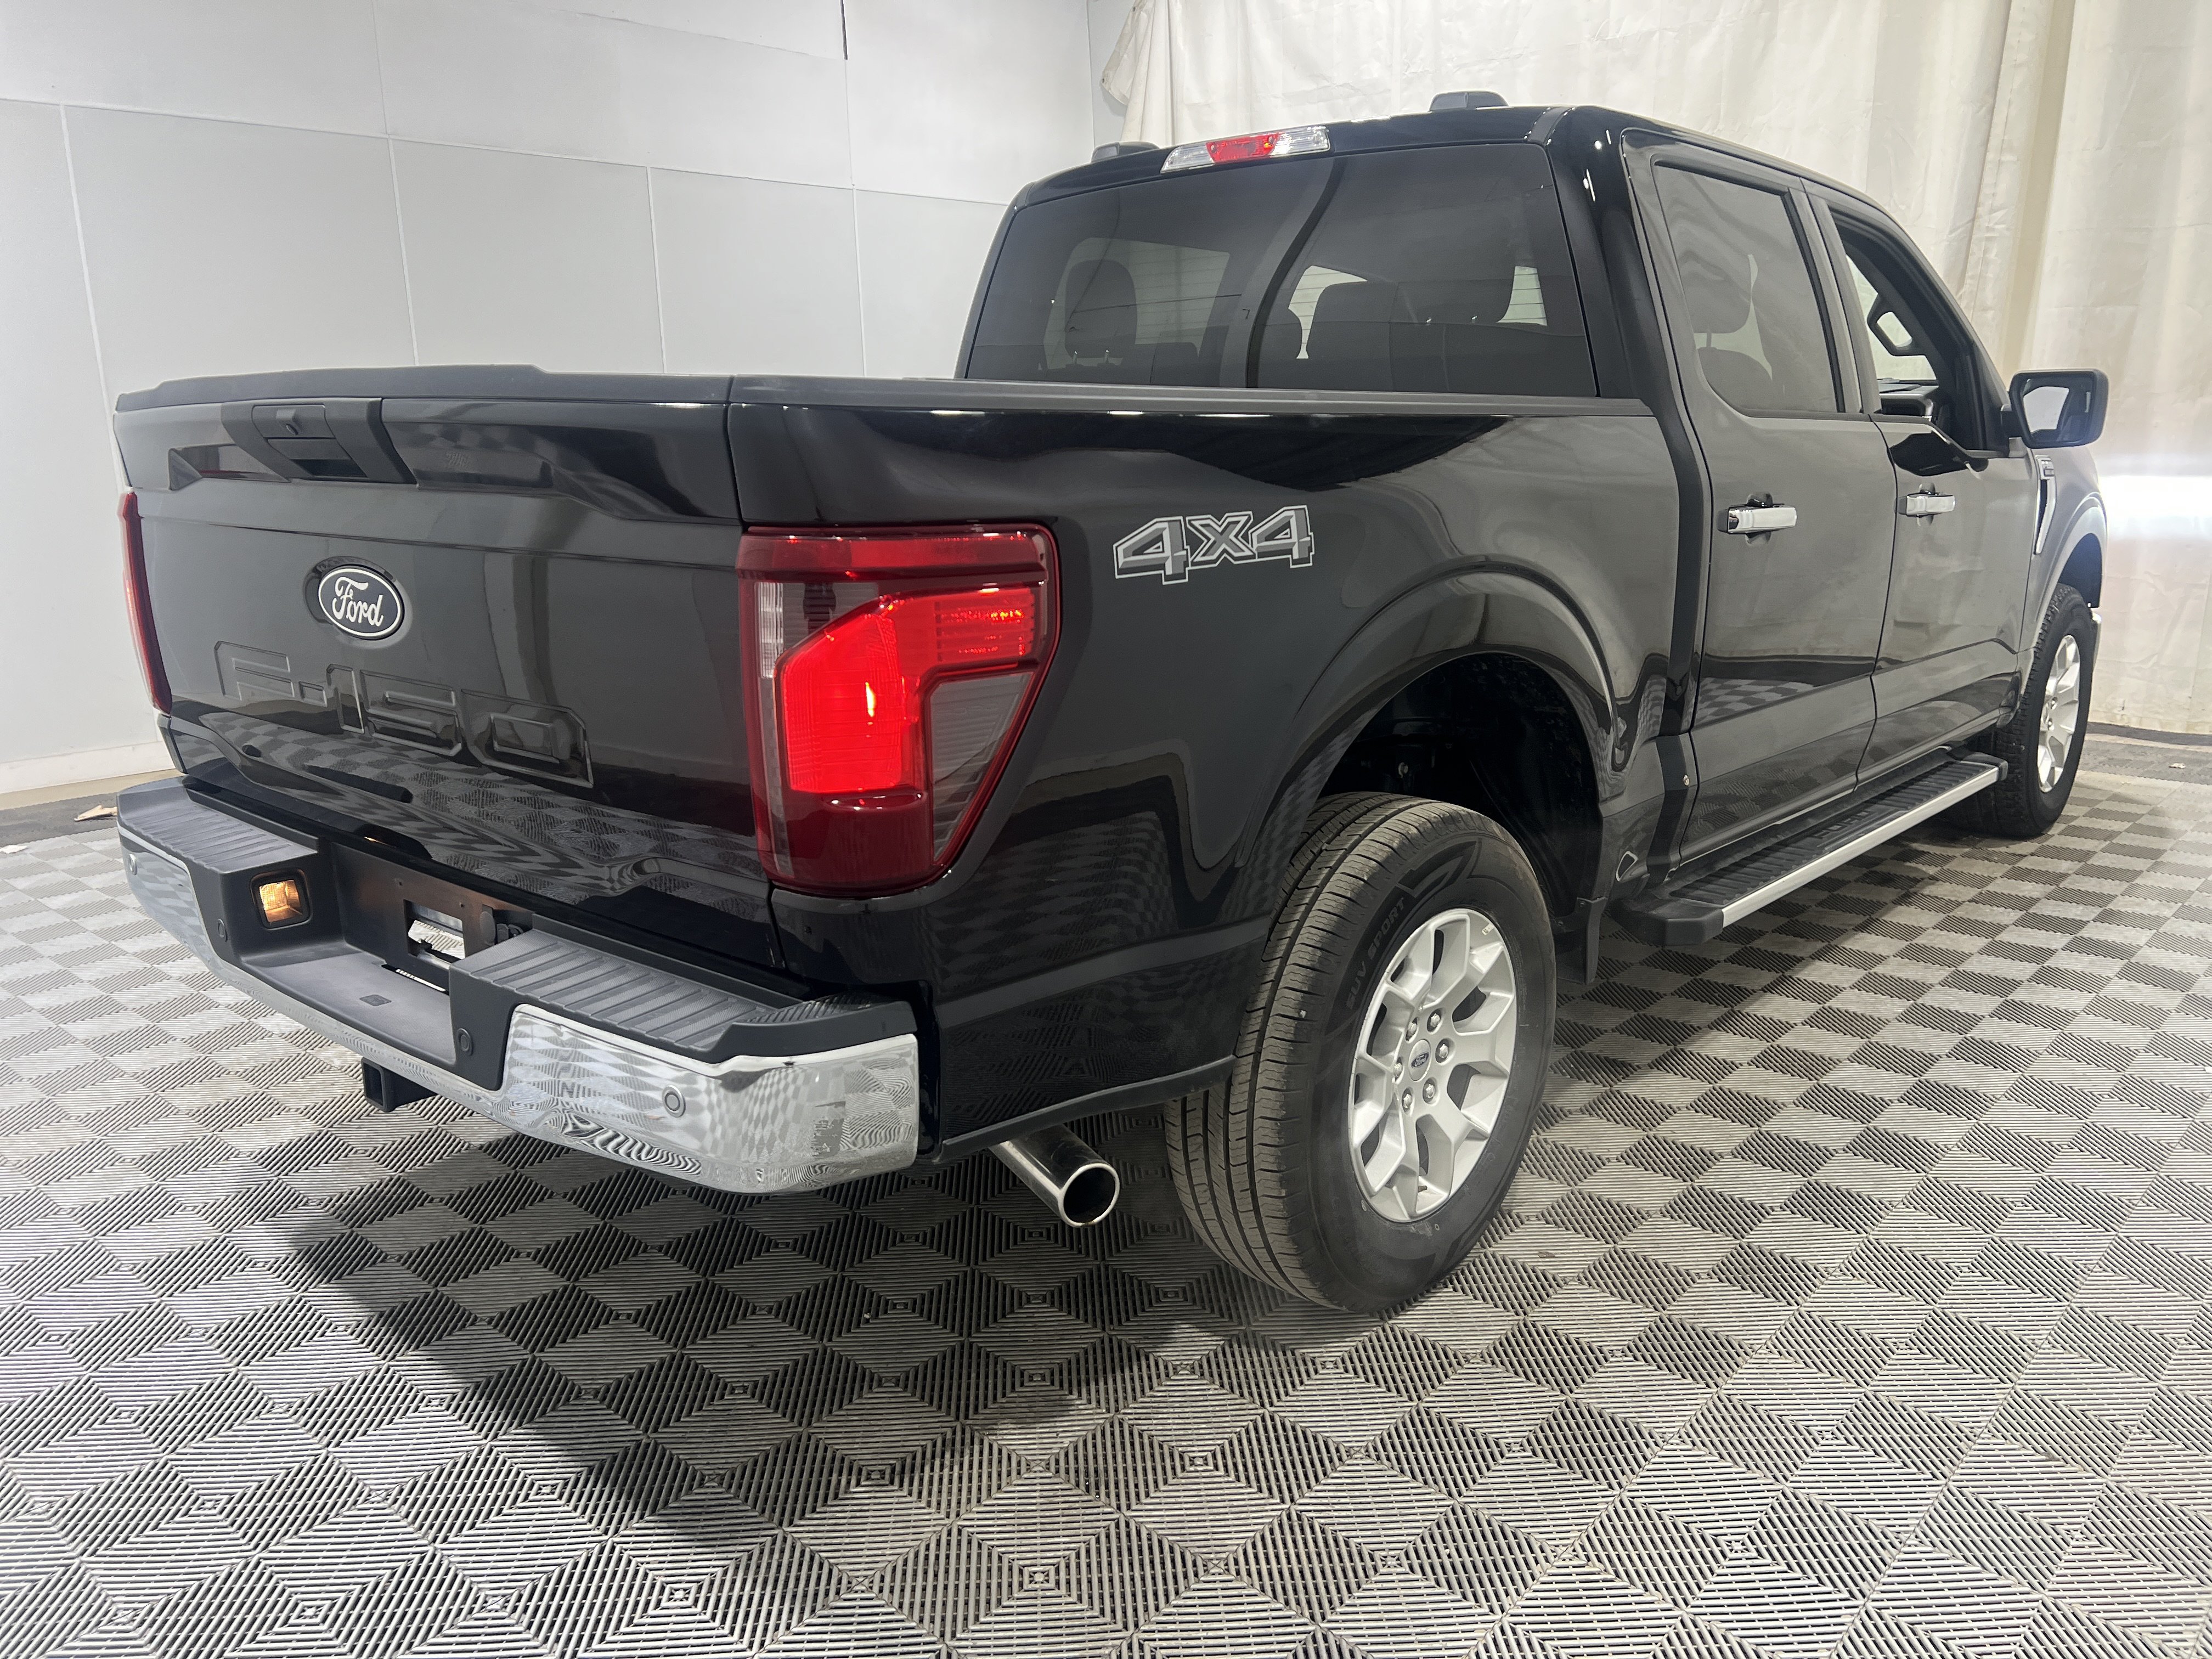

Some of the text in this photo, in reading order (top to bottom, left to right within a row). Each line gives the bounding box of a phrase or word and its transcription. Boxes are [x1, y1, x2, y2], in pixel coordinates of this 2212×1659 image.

[332, 576, 384, 627] Ford
[214, 641, 594, 788] F-150
[1346, 896, 1404, 1009] SUV SPORT
